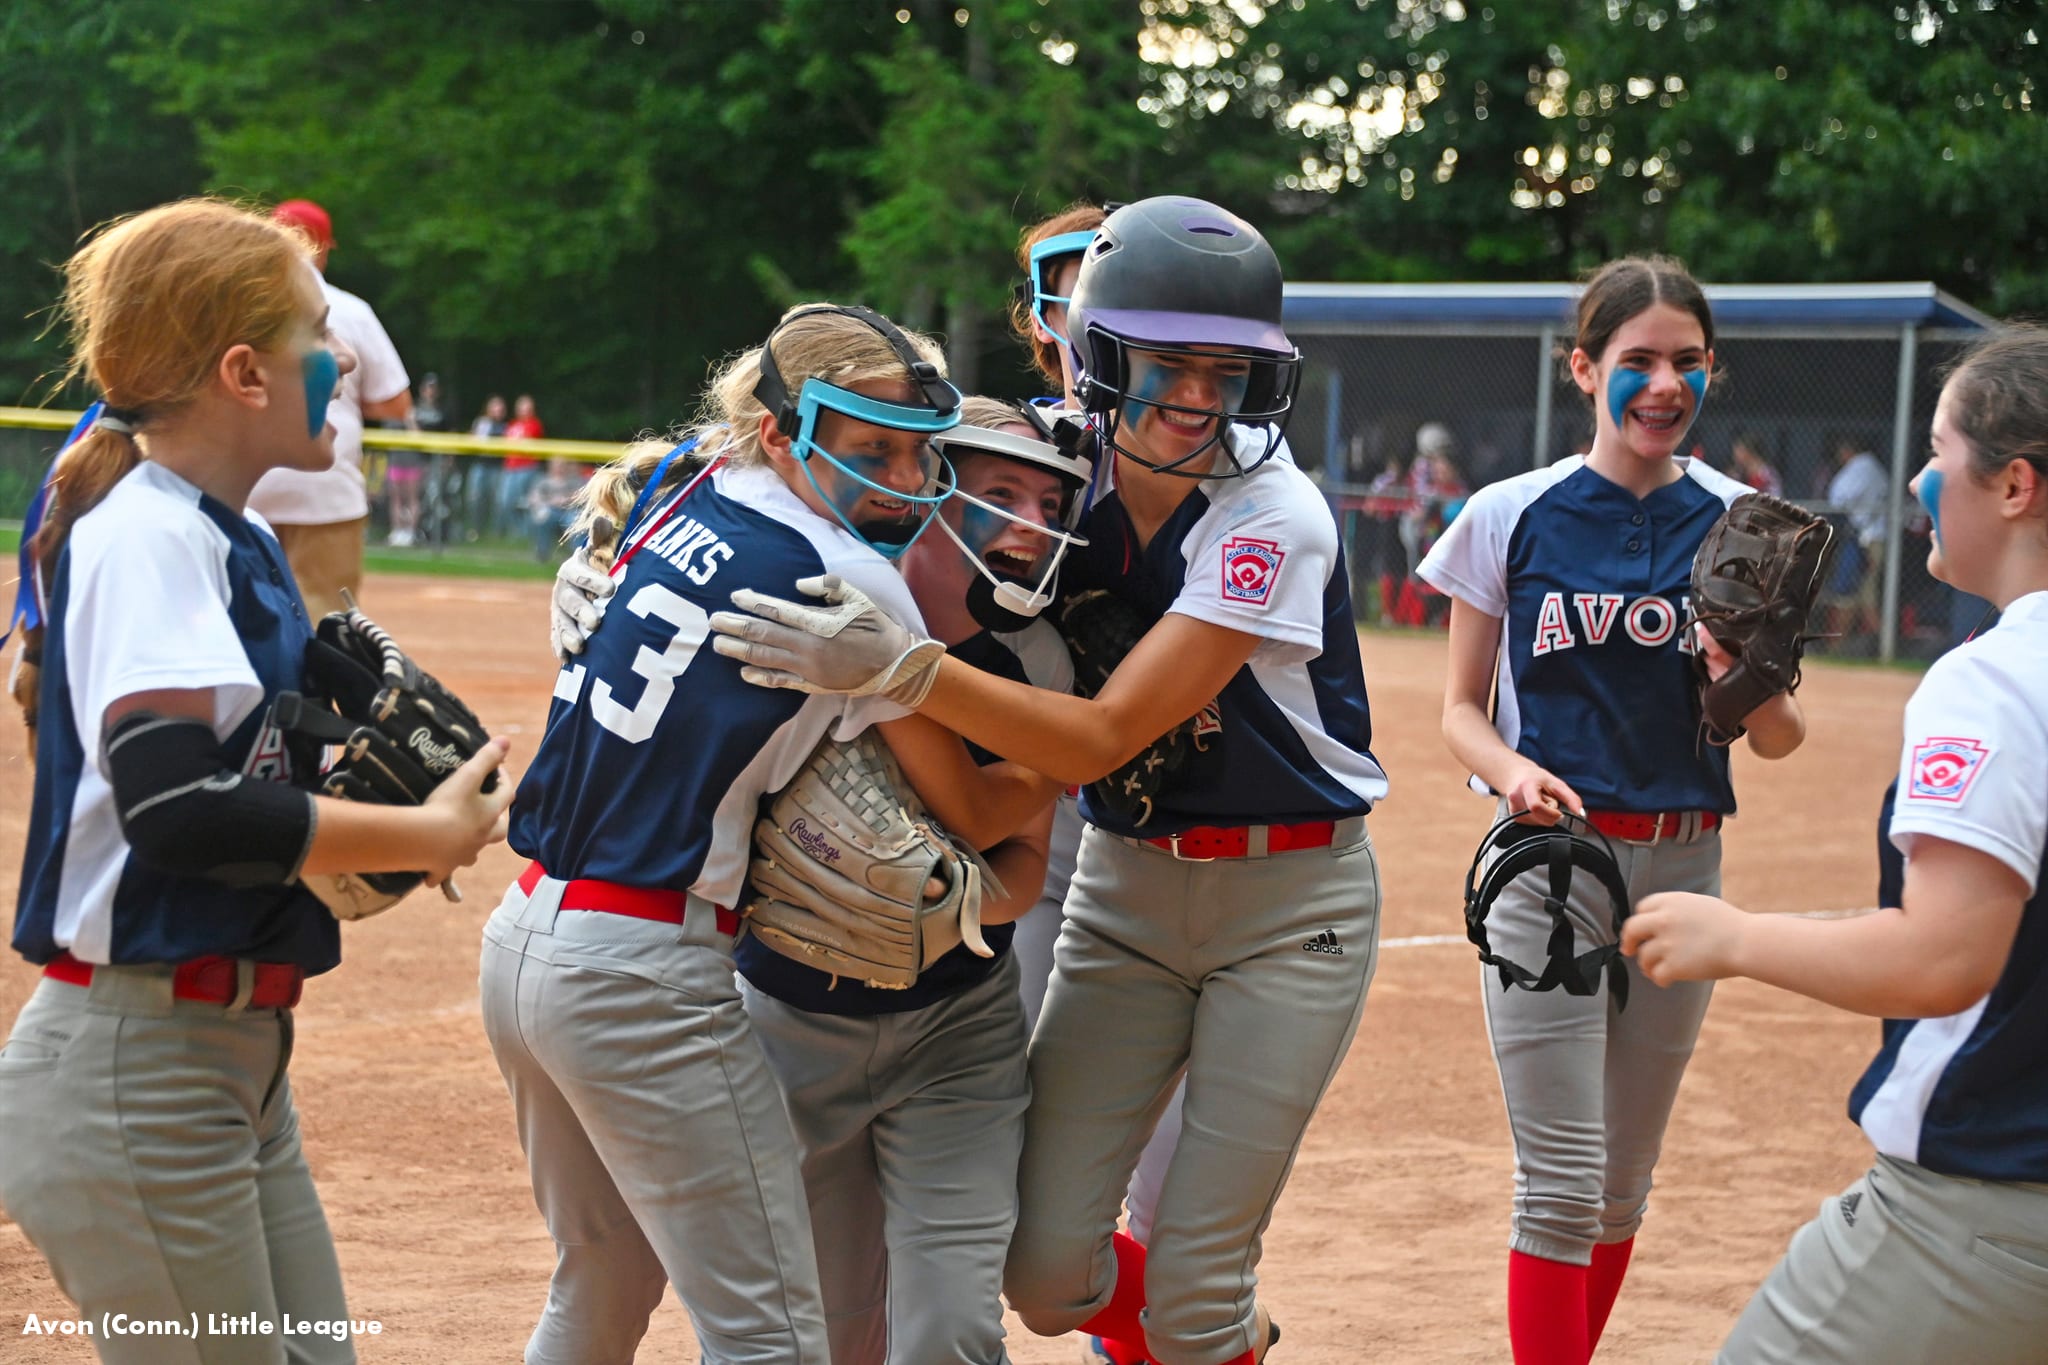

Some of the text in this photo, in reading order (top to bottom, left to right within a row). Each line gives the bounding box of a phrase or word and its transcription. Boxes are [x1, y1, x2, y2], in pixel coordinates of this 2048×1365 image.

[1230, 585, 1262, 597] SOFTBALL
[408, 726, 467, 774] Rawlin
[789, 817, 842, 863] Rawlings
[1302, 940, 1344, 956] adidas
